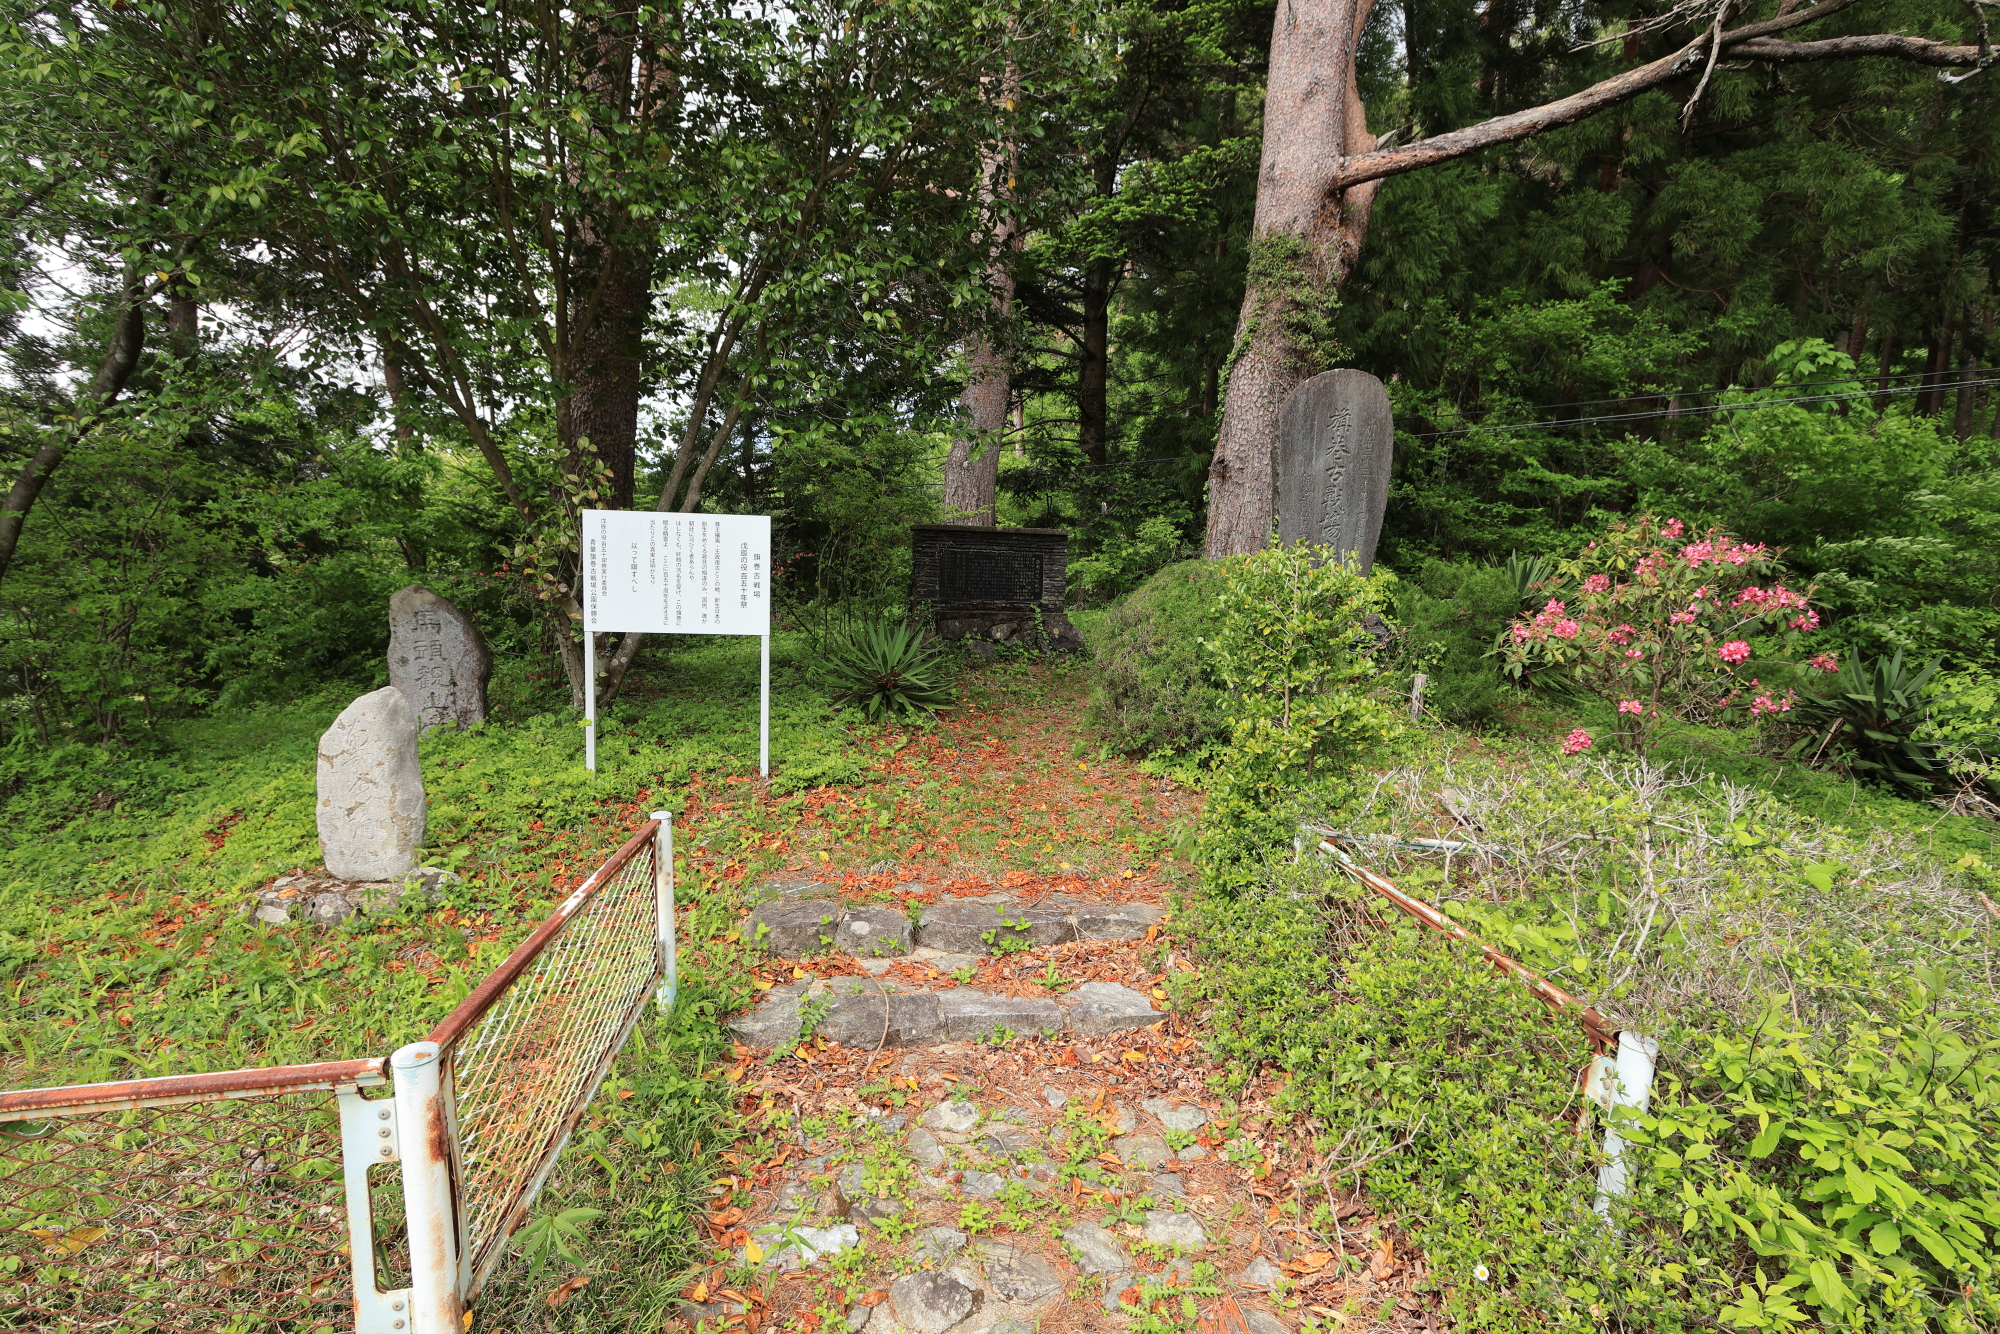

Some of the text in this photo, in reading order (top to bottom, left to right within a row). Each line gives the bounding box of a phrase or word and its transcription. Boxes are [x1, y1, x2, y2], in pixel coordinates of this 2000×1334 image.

[740, 542, 748, 608] 戊辰の役百五十年祭
[753, 553, 761, 598] 旗巻古戦場
